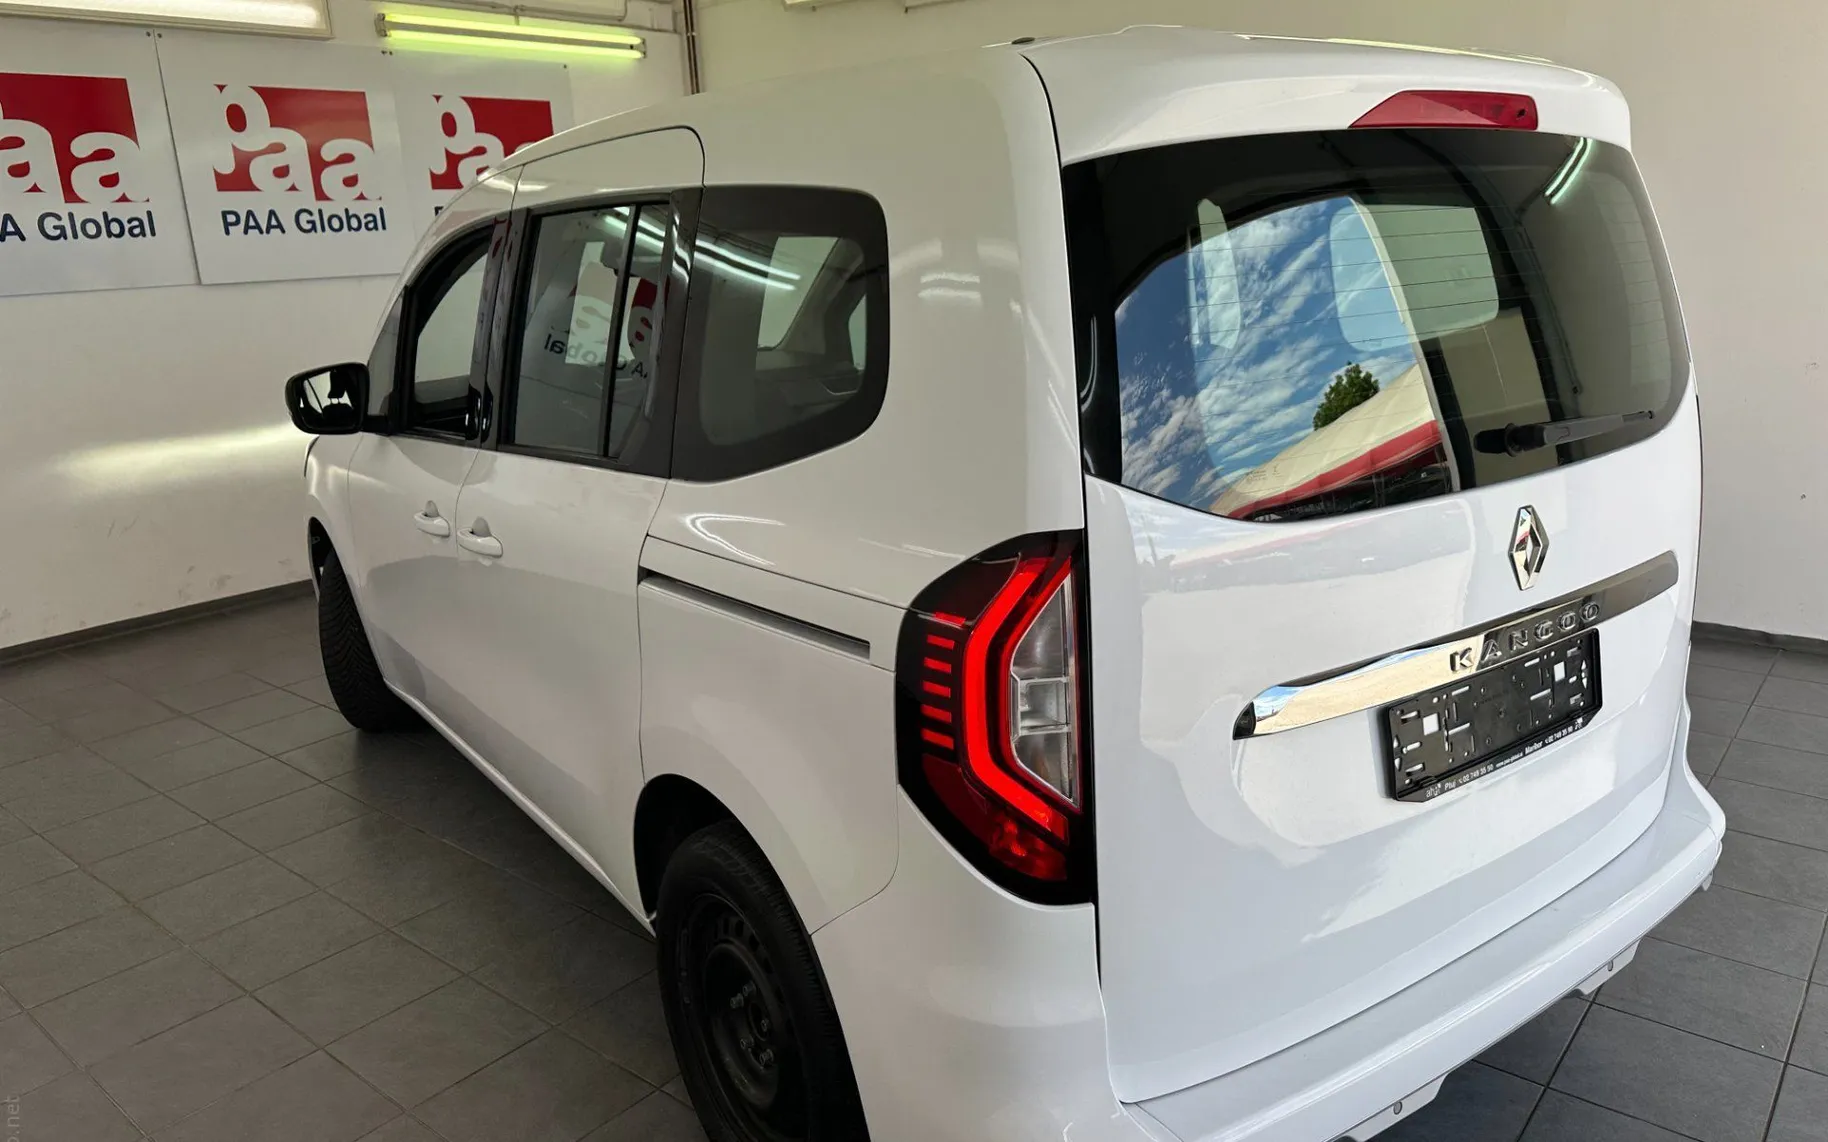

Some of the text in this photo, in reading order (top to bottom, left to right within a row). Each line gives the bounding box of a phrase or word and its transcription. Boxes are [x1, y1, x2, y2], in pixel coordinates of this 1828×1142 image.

[37, 210, 157, 241] Global
[221, 206, 387, 236] PAA Global
[1450, 601, 1600, 672] KANGOO
